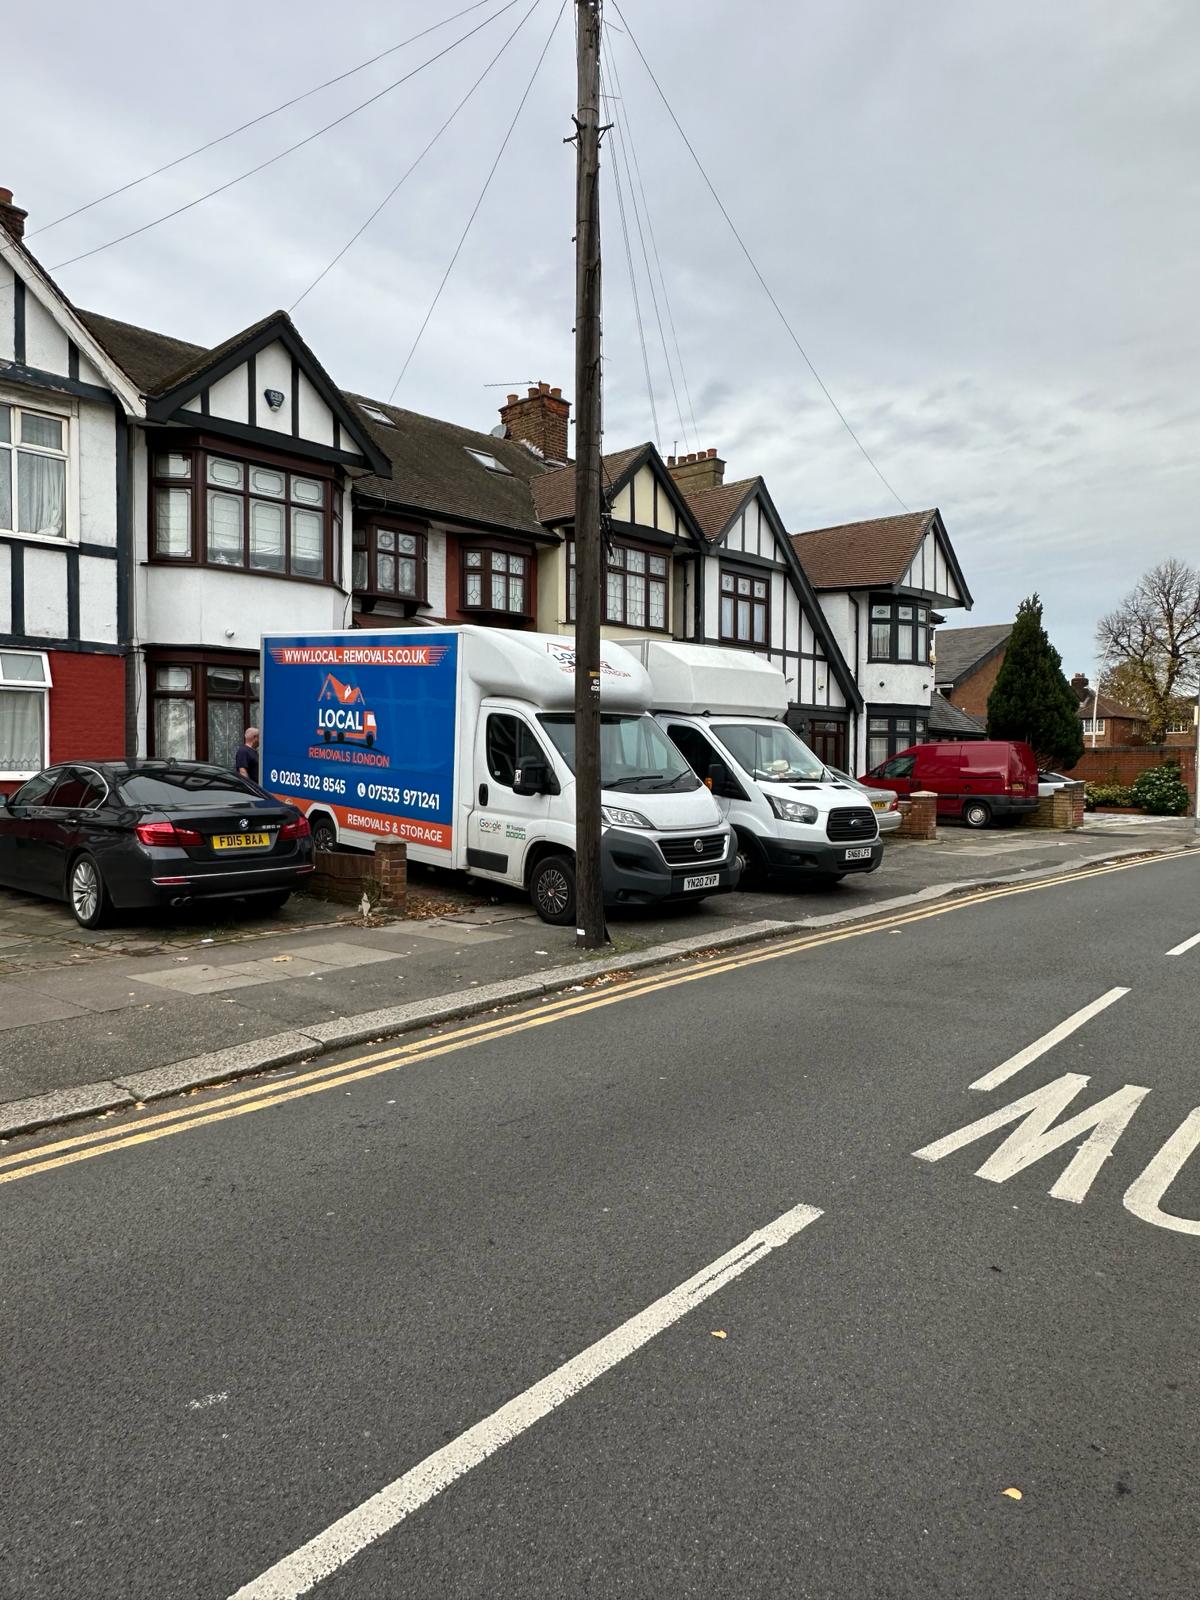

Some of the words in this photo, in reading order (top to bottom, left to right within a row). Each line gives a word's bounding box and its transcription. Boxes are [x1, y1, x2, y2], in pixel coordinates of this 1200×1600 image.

[318, 708, 363, 731] LOCAL
[308, 747, 351, 763] REMOVALS
[351, 751, 390, 768] LONDON
[279, 770, 301, 786] 0203
[303, 773, 320, 790] 302
[322, 776, 346, 794] 8545
[367, 784, 400, 803] 07533
[403, 789, 440, 810] 971241
[347, 813, 390, 832] REMOVALS
[392, 822, 398, 832] &
[400, 824, 443, 843] STORAGE
[479, 817, 502, 831] Google
[219, 835, 243, 847] FD15
[245, 834, 264, 845] BAA
[687, 877, 704, 889] YN20
